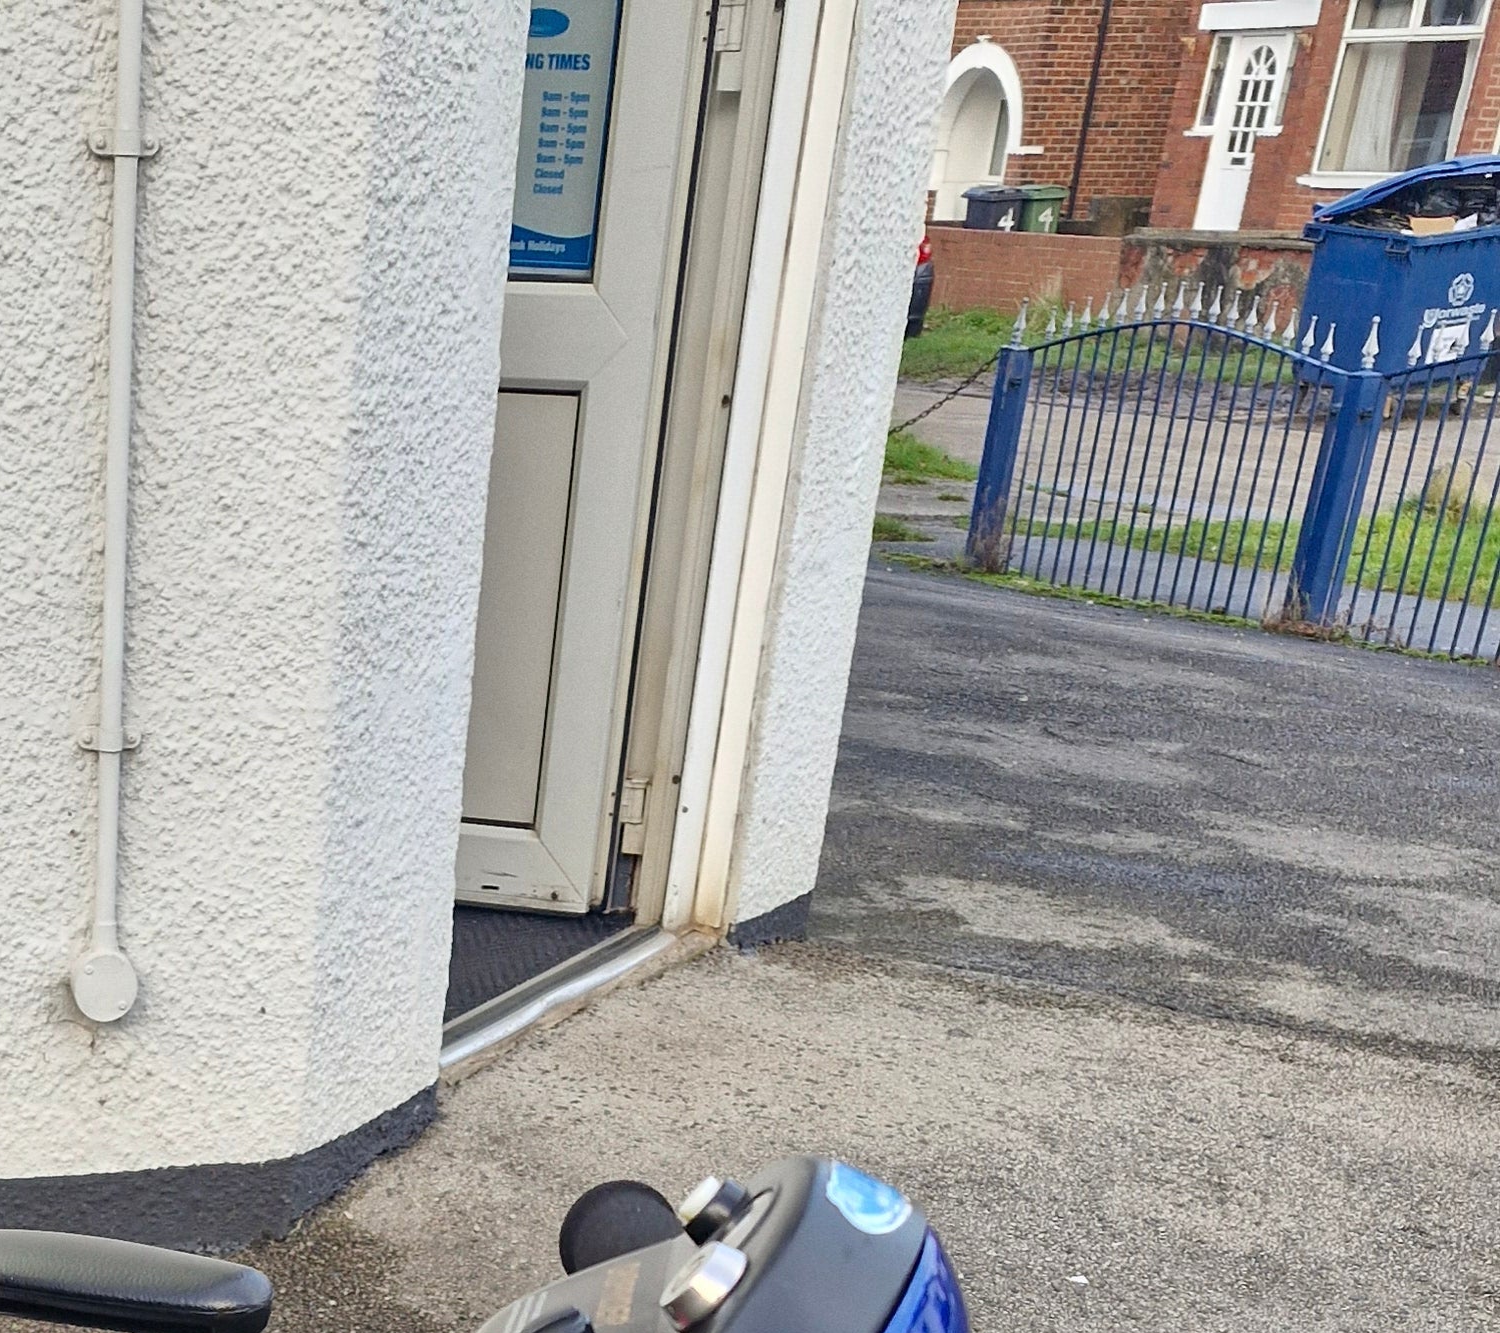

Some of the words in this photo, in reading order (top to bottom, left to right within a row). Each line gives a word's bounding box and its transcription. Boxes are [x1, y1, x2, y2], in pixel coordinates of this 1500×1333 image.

[548, 53, 590, 70] TIMES
[534, 168, 565, 180] Closed
[533, 183, 563, 195] Closed
[997, 207, 1015, 232] 4
[1038, 207, 1054, 232] 4
[527, 240, 566, 255] Holidays
